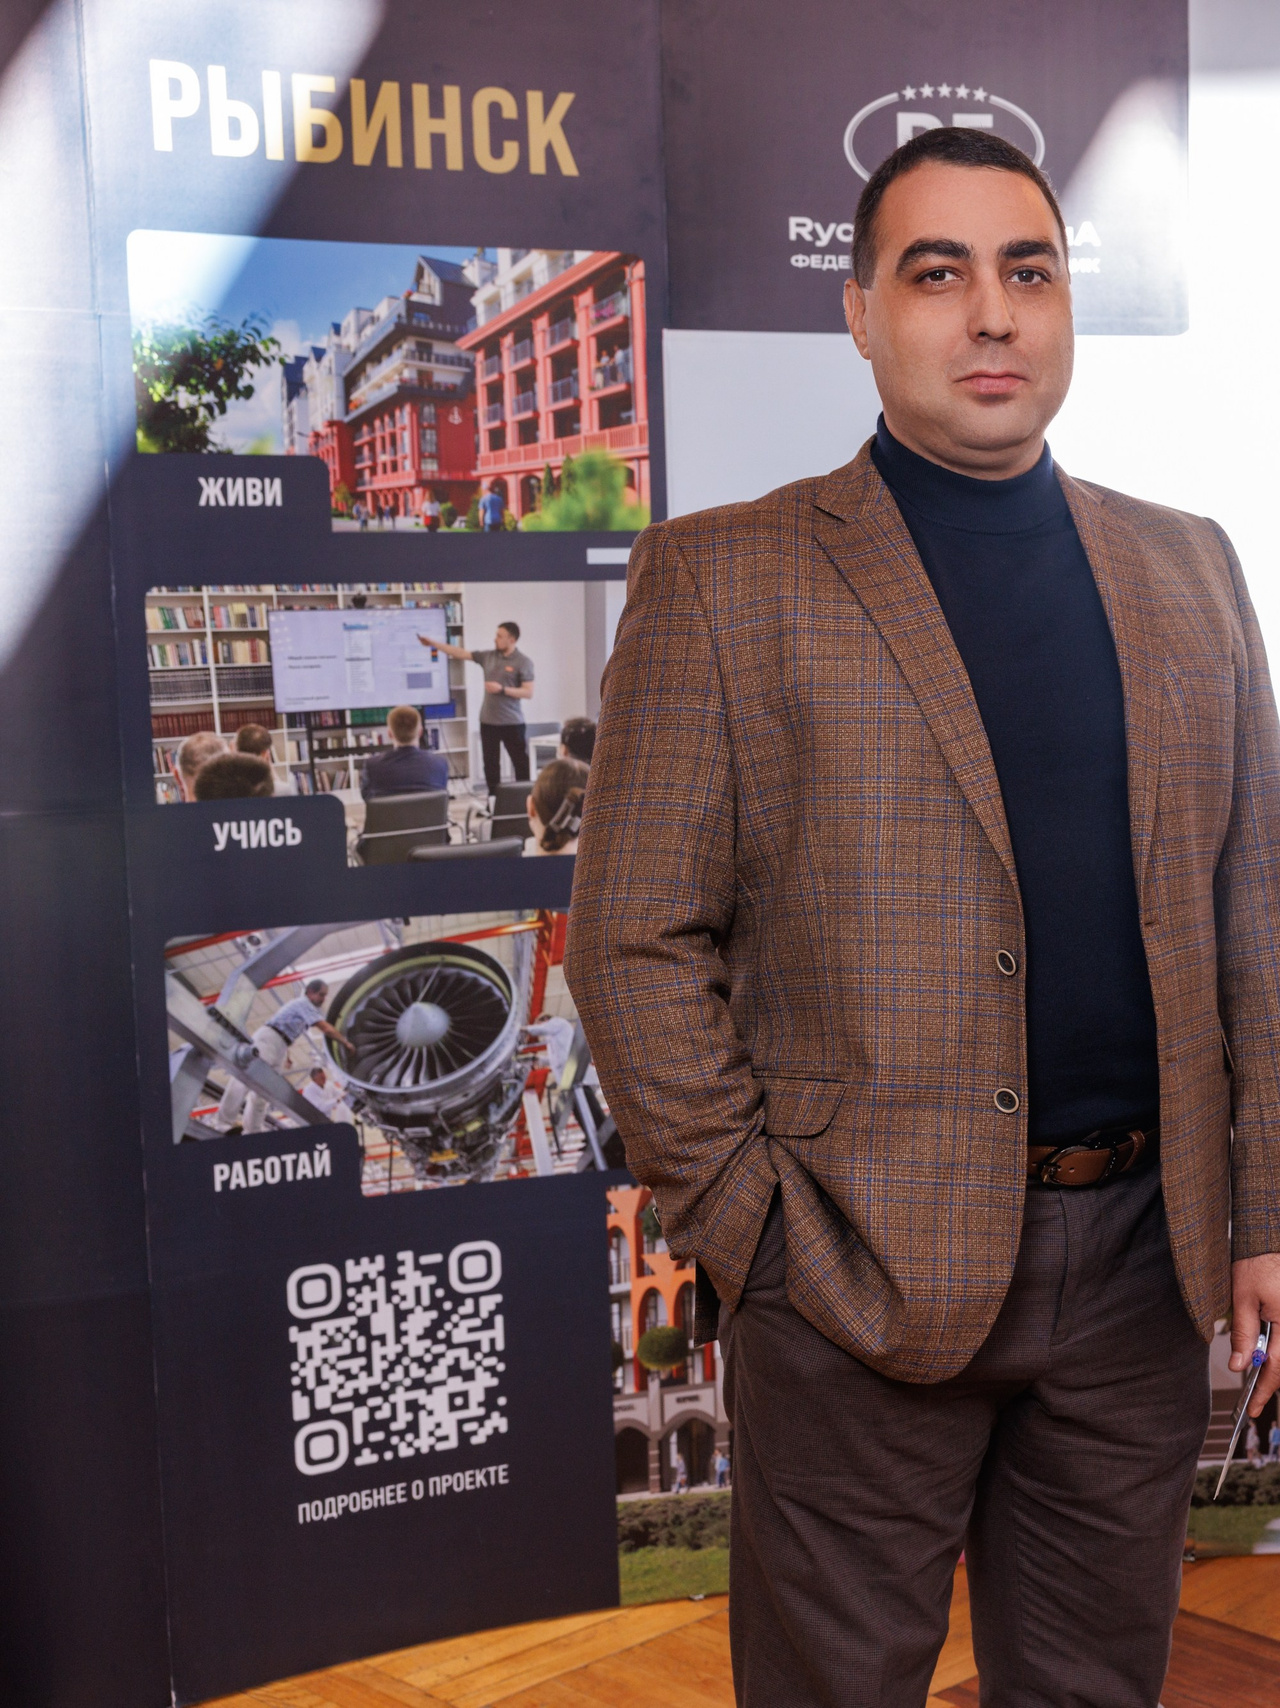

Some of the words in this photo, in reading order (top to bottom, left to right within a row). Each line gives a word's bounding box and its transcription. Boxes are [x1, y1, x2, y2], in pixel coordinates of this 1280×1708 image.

[148, 58, 580, 177] РЫБИНСК
[198, 476, 283, 507] ЖИВИ
[213, 817, 302, 852] УЧИСЬ
[213, 1143, 332, 1192] РАБОТАЙ
[298, 1482, 407, 1525] ПОДРОБНЕЕ
[411, 1479, 424, 1500] О
[428, 1463, 510, 1497] ПРОЕКТЕ
